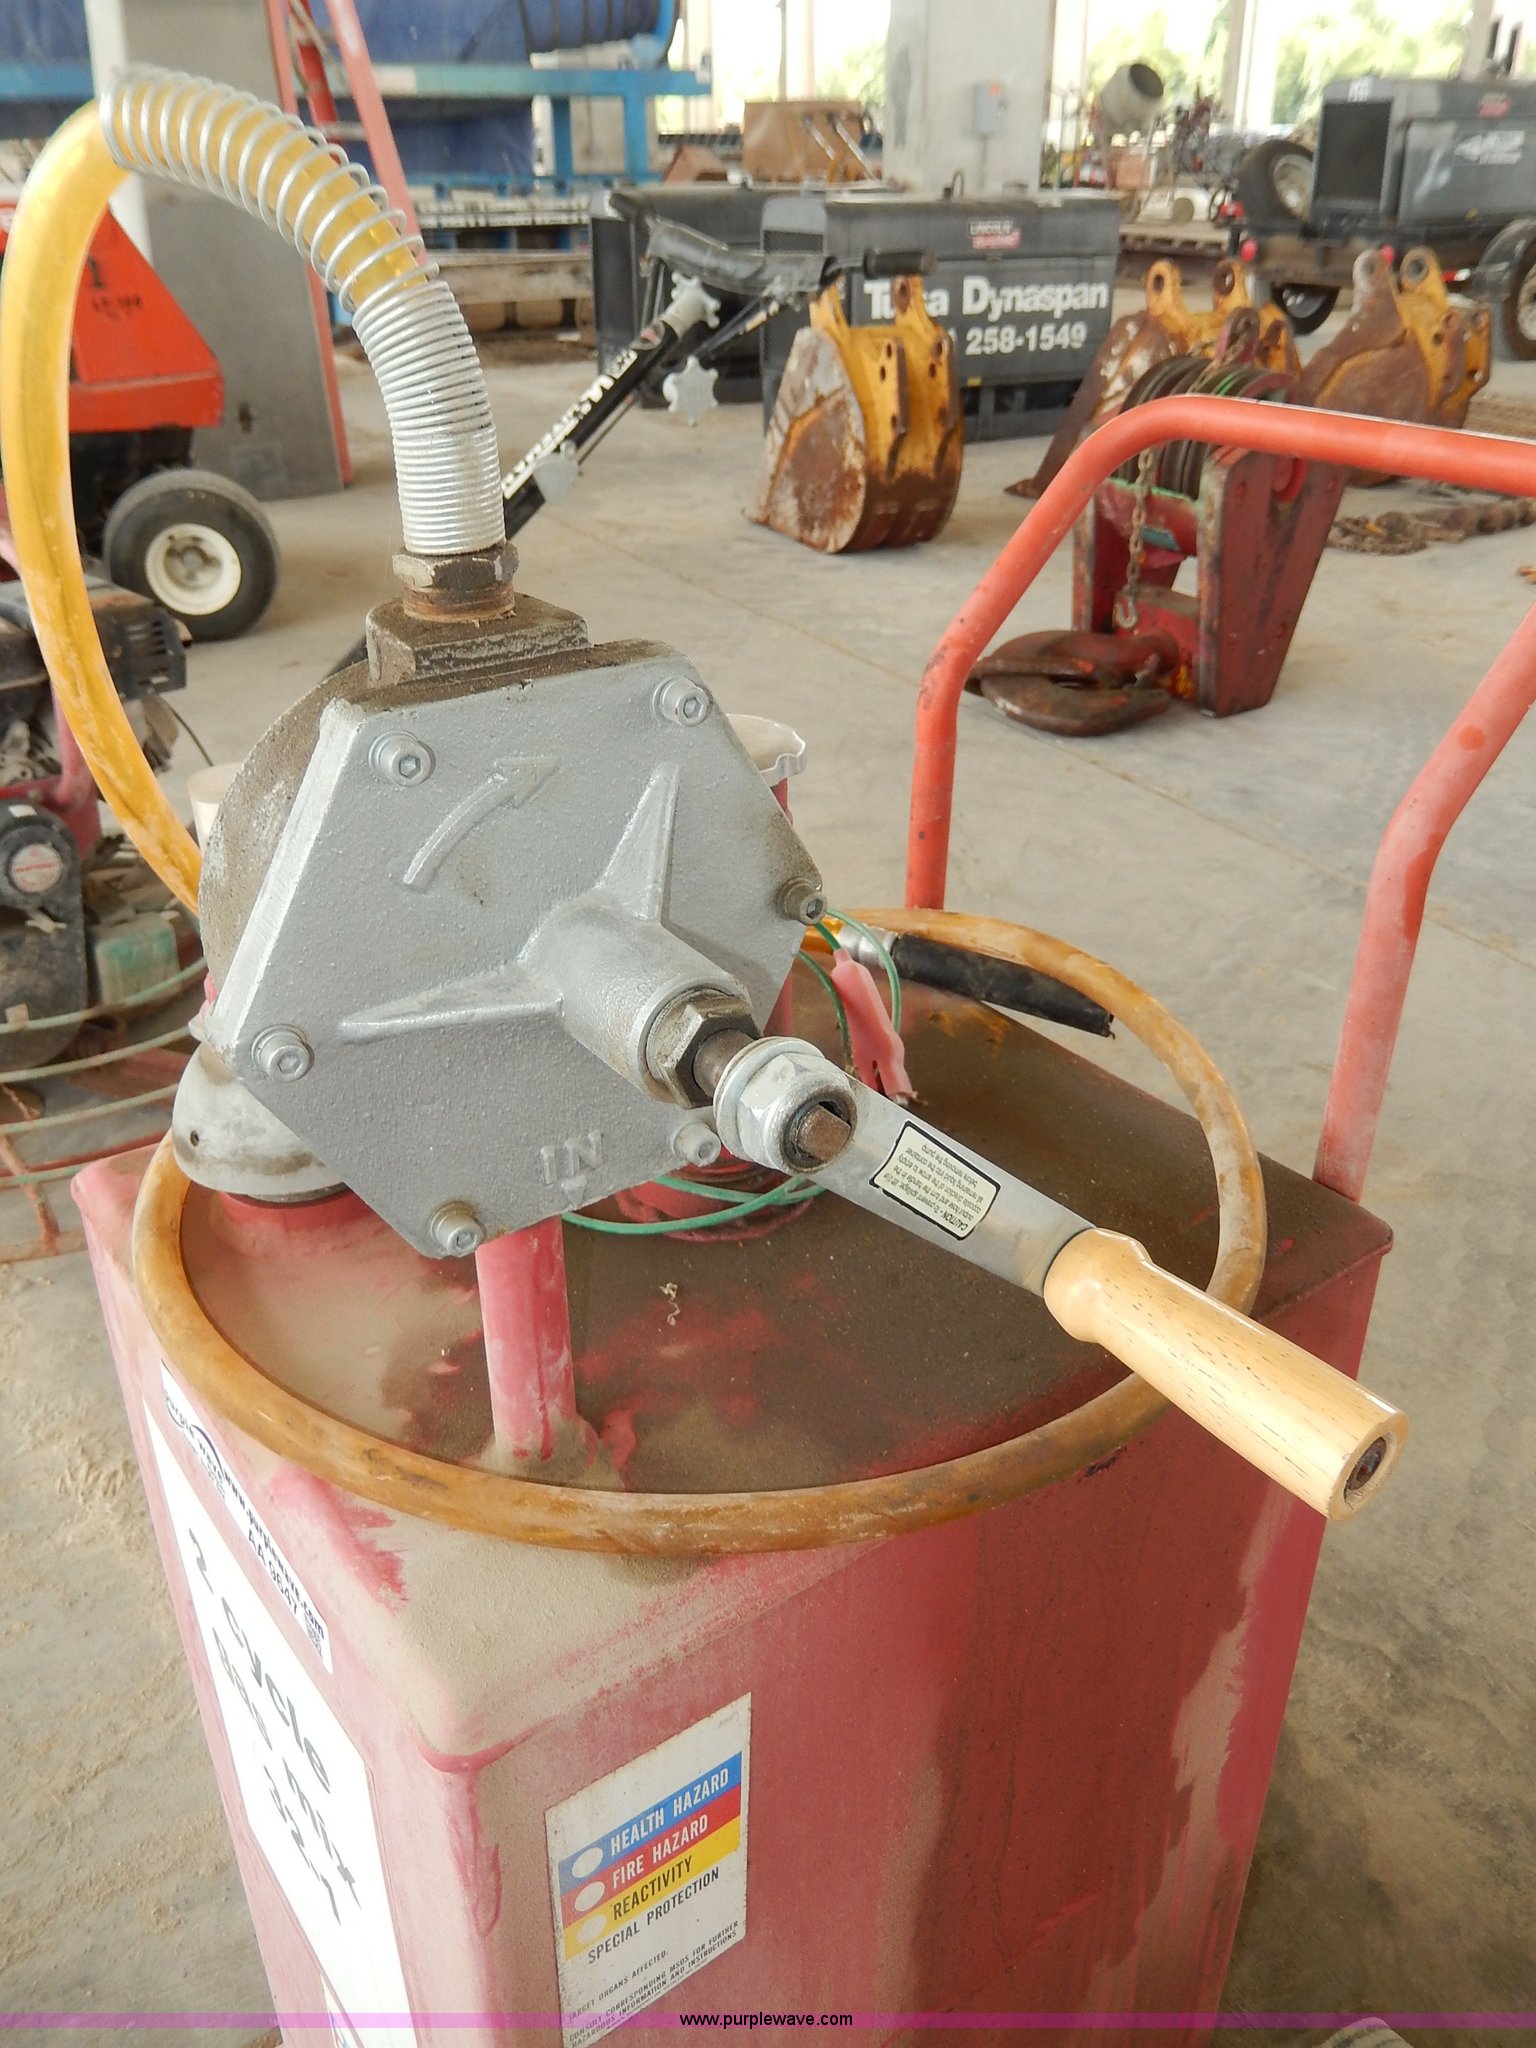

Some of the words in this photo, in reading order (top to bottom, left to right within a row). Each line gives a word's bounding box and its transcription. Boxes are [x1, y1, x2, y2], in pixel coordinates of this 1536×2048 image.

[863, 279, 949, 319] Tua
[963, 275, 1109, 322] Dynaspan
[965, 321, 1087, 355] 258-1549
[941, 1210, 967, 1230] CAUTION
[188, 1527, 214, 1595] 2
[221, 1596, 330, 1795] cycle
[211, 1626, 273, 1752] gas
[281, 1755, 362, 1911] mix
[611, 1807, 665, 1856] HEALTH
[673, 1768, 729, 1817] HAZARD
[263, 1764, 341, 1927] 32-1
[613, 1854, 645, 1889] FIRE
[652, 1814, 708, 1864] HAZARD
[613, 1855, 693, 1921] REACTIVITY
[588, 1921, 640, 1965] SPECIAL
[647, 1867, 720, 1926] PROTECTION
[605, 1972, 667, 2017] CORRESPONDING
[692, 1944, 706, 1957] FOR
[708, 1920, 739, 1945] FURTHER
[619, 1979, 667, 2017] INFORMATION
[670, 1966, 686, 1982] AND
[688, 1929, 738, 1968] INSTRUCTIONS
